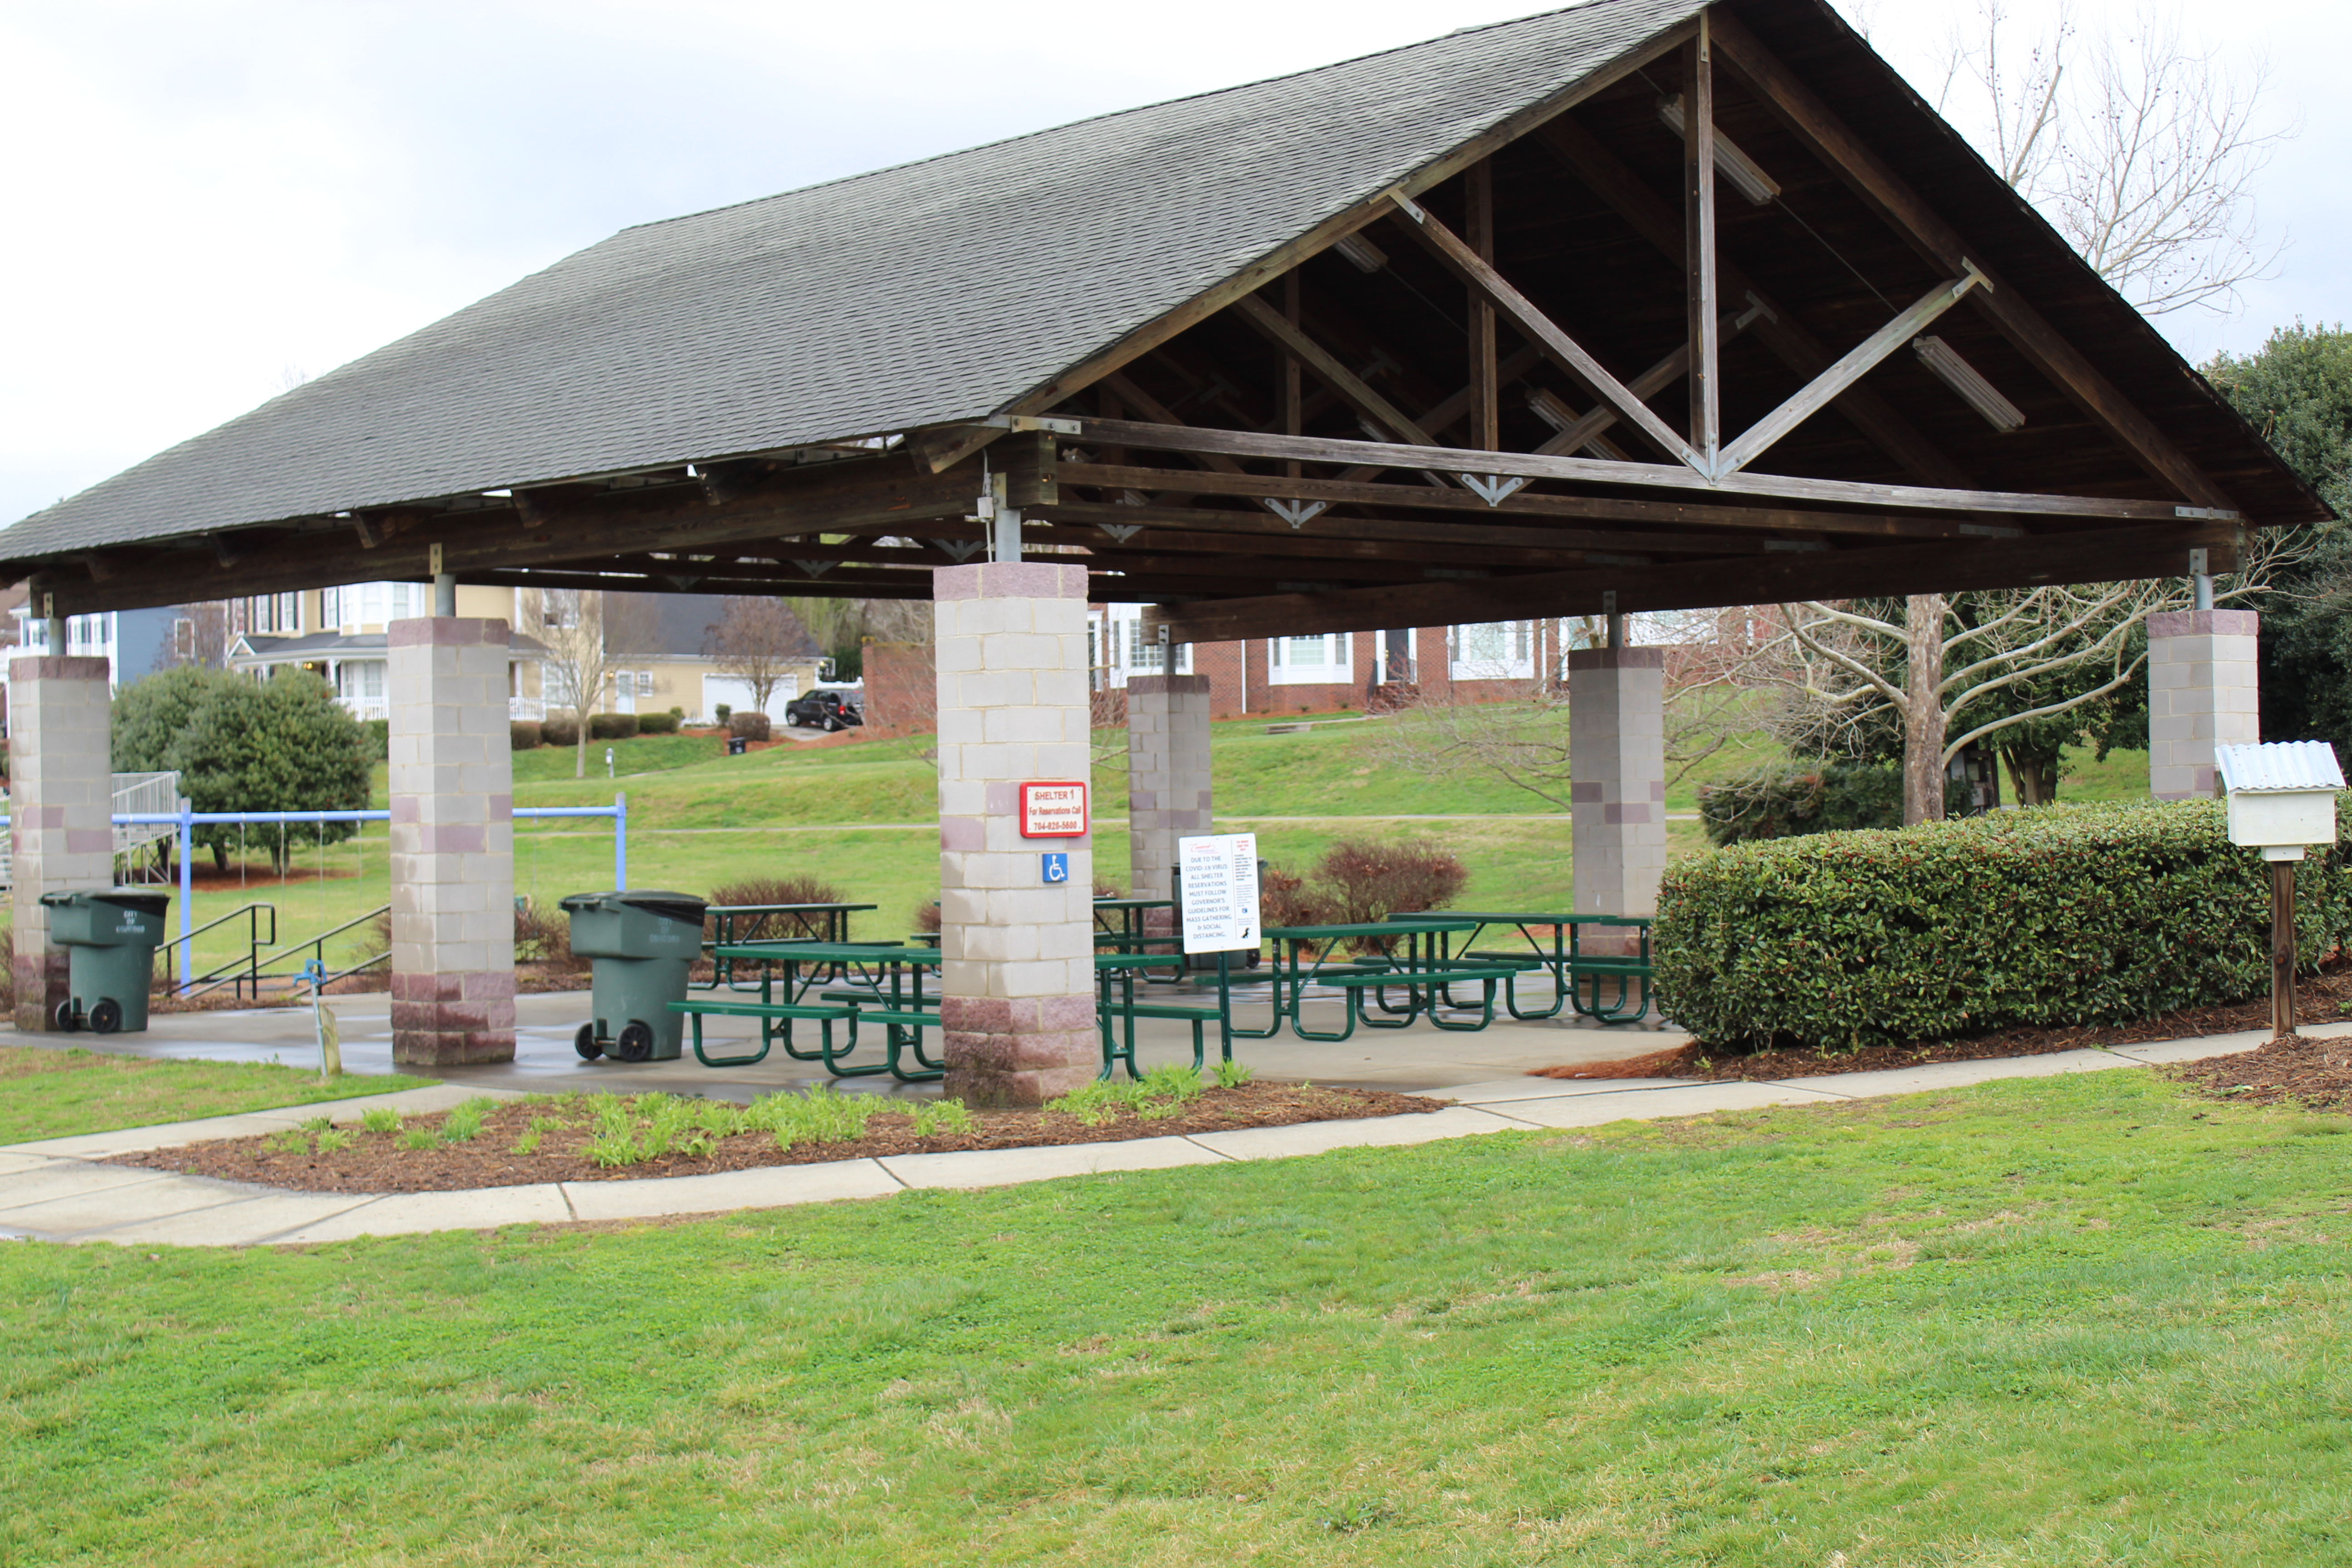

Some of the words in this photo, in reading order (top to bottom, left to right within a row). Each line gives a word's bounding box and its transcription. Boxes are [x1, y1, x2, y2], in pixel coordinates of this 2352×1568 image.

[1035, 791, 1068, 800] SHELTER
[1070, 789, 1074, 799] 1
[1029, 807, 1037, 815] For
[1039, 806, 1070, 815] Reservations
[1072, 805, 1081, 814] Call
[1188, 880, 1227, 888] RESERVATIONS
[123, 910, 138, 918] CITY
